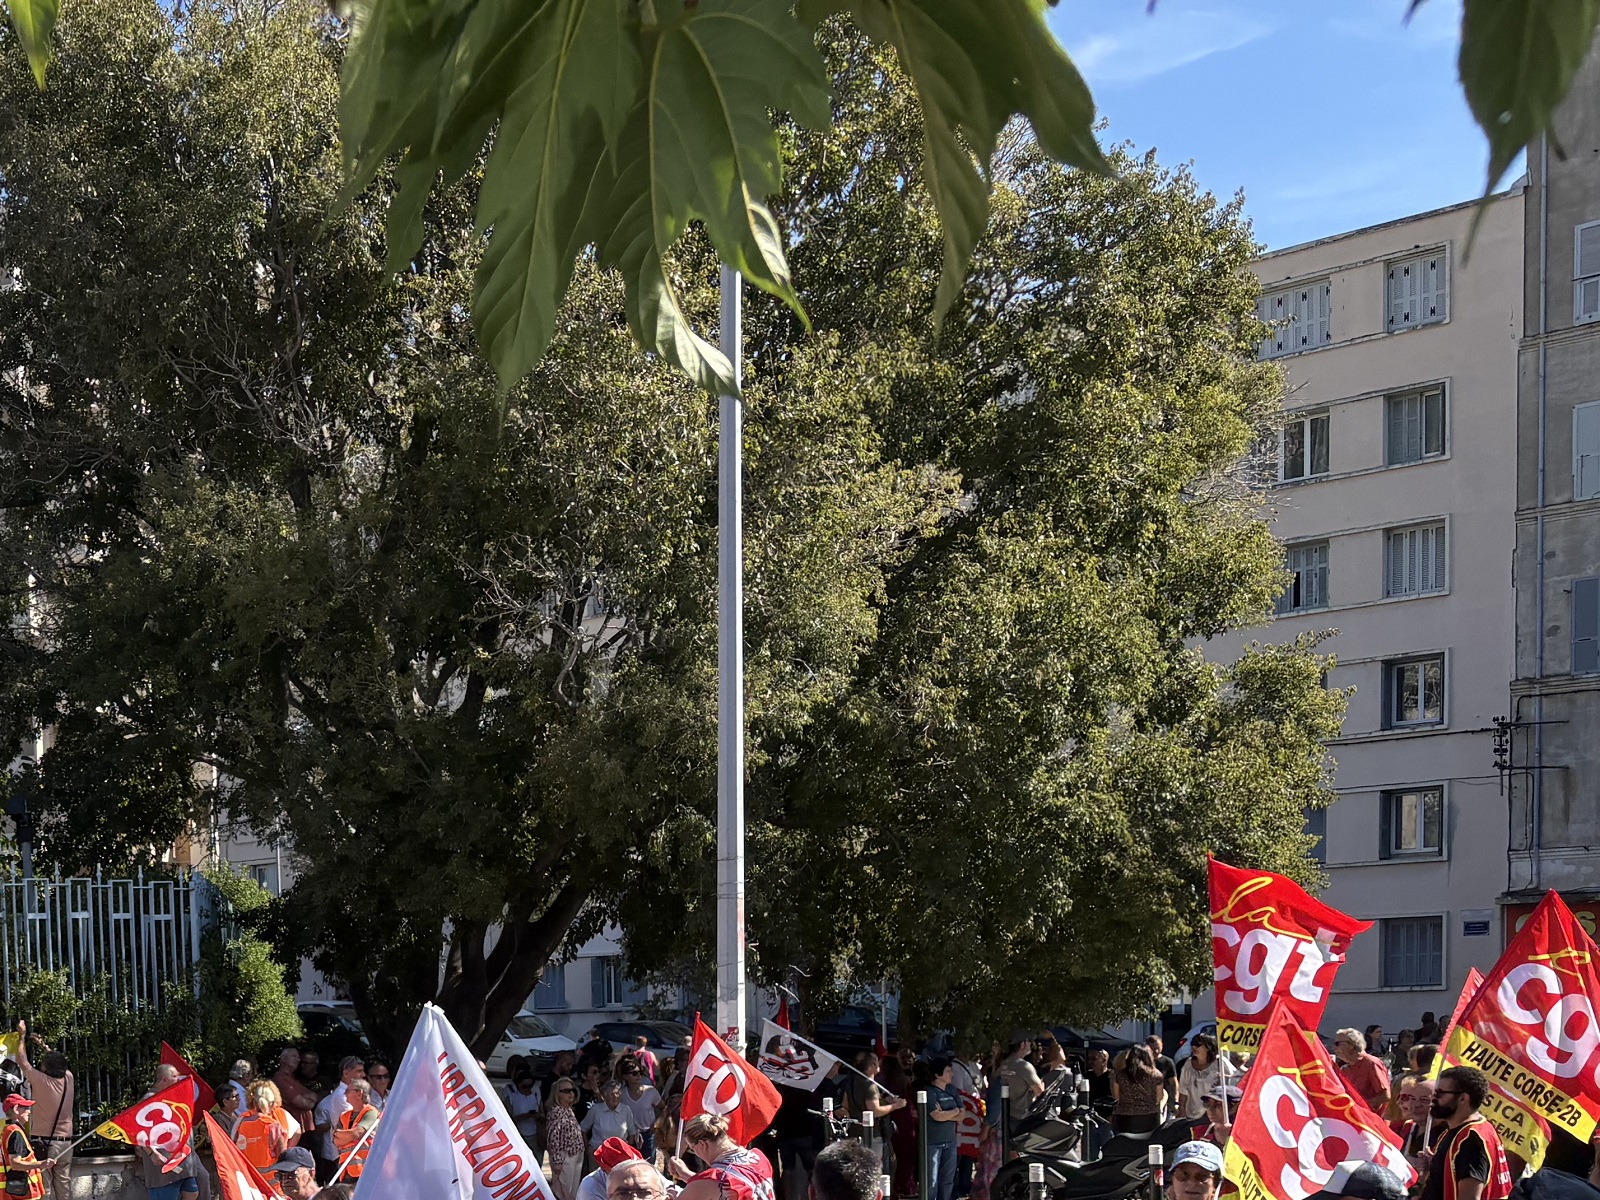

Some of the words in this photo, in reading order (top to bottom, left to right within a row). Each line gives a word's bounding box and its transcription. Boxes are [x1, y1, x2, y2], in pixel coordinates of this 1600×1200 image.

[1497, 963, 1600, 1088] cg
[1461, 1041, 1515, 1082] HAUTE
[1512, 1071, 1582, 1128] CORSE-2B
